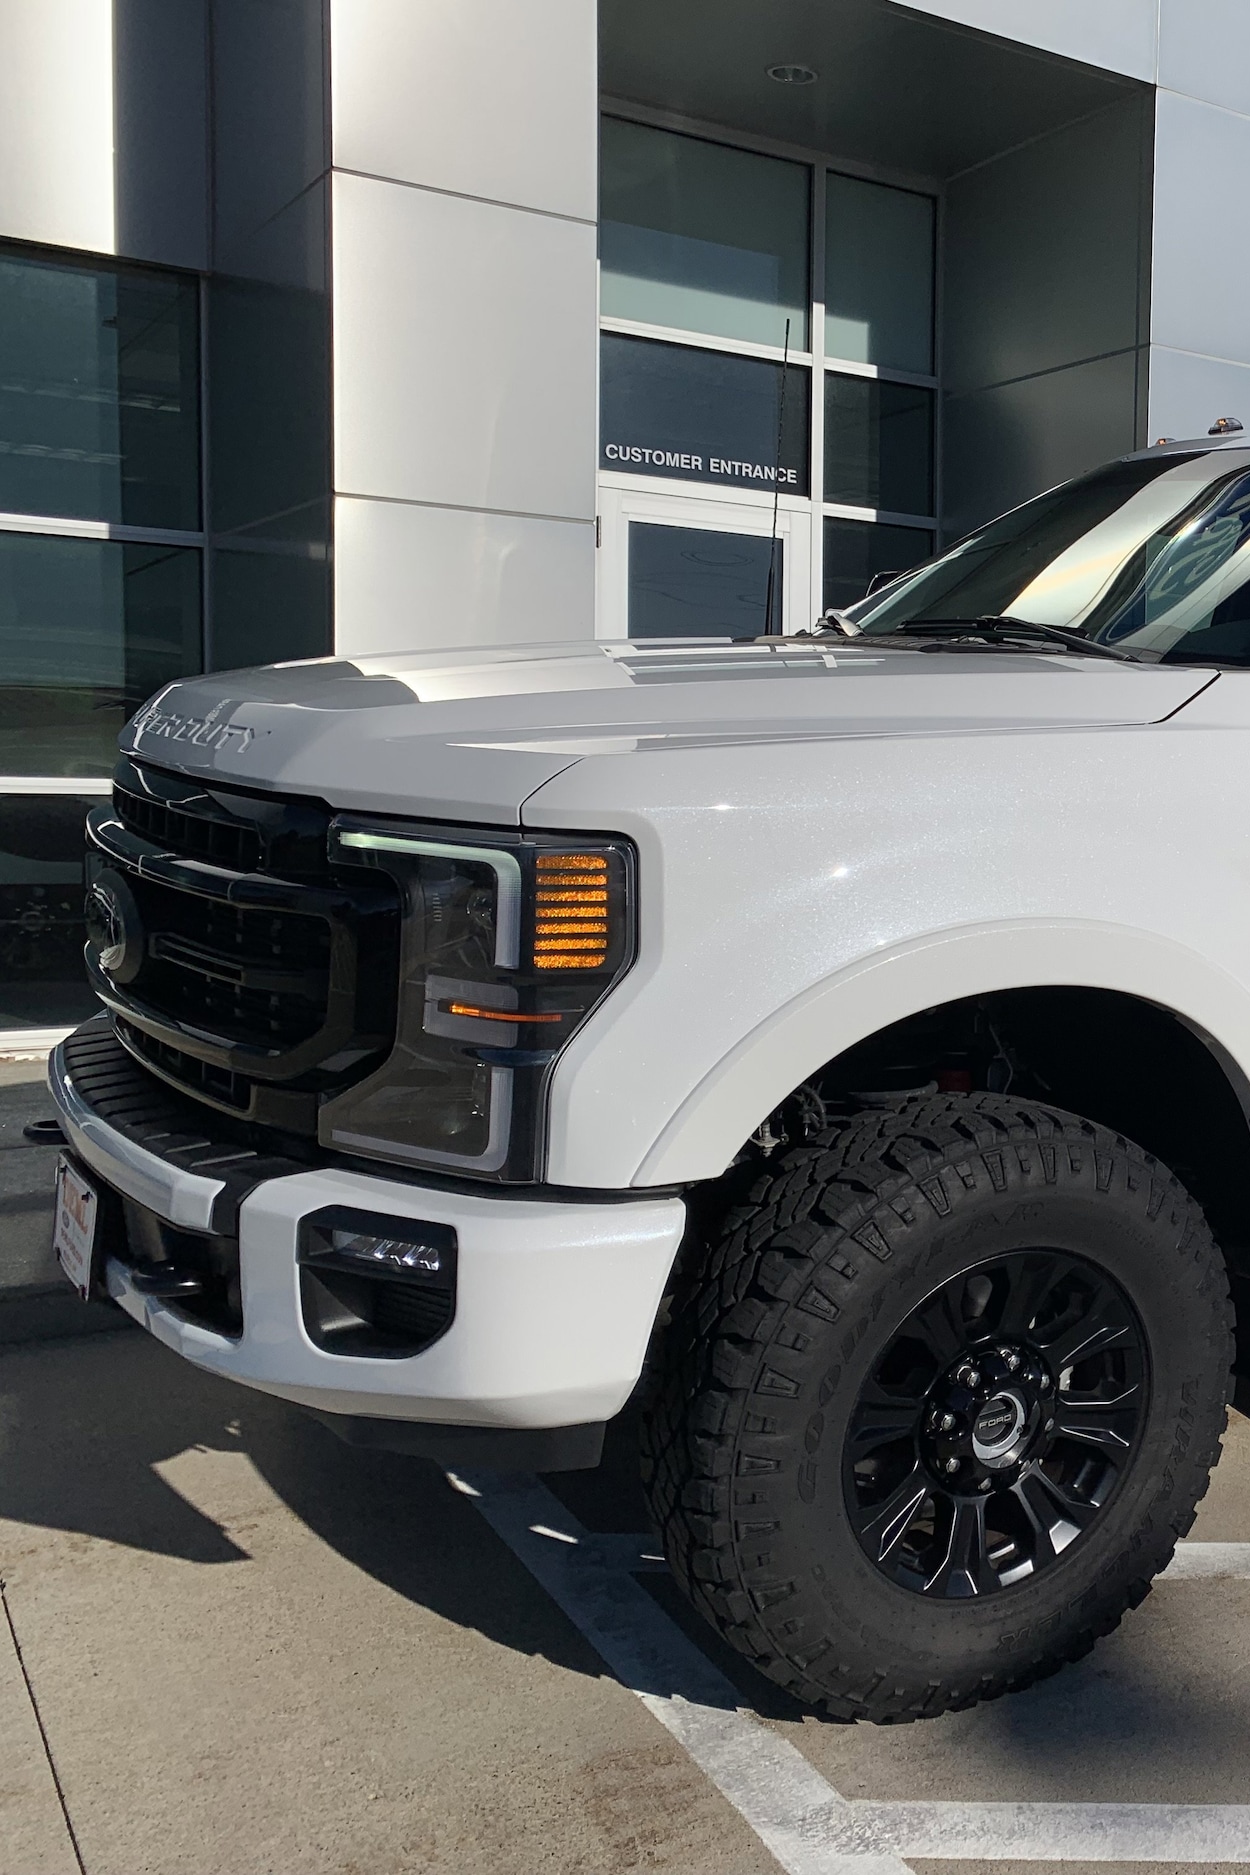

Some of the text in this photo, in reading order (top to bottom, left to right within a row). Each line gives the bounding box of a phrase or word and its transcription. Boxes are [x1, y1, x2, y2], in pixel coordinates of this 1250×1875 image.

[605, 443, 797, 484] CUSTOMER ENTRANCE
[978, 1413, 1012, 1430] FORD
